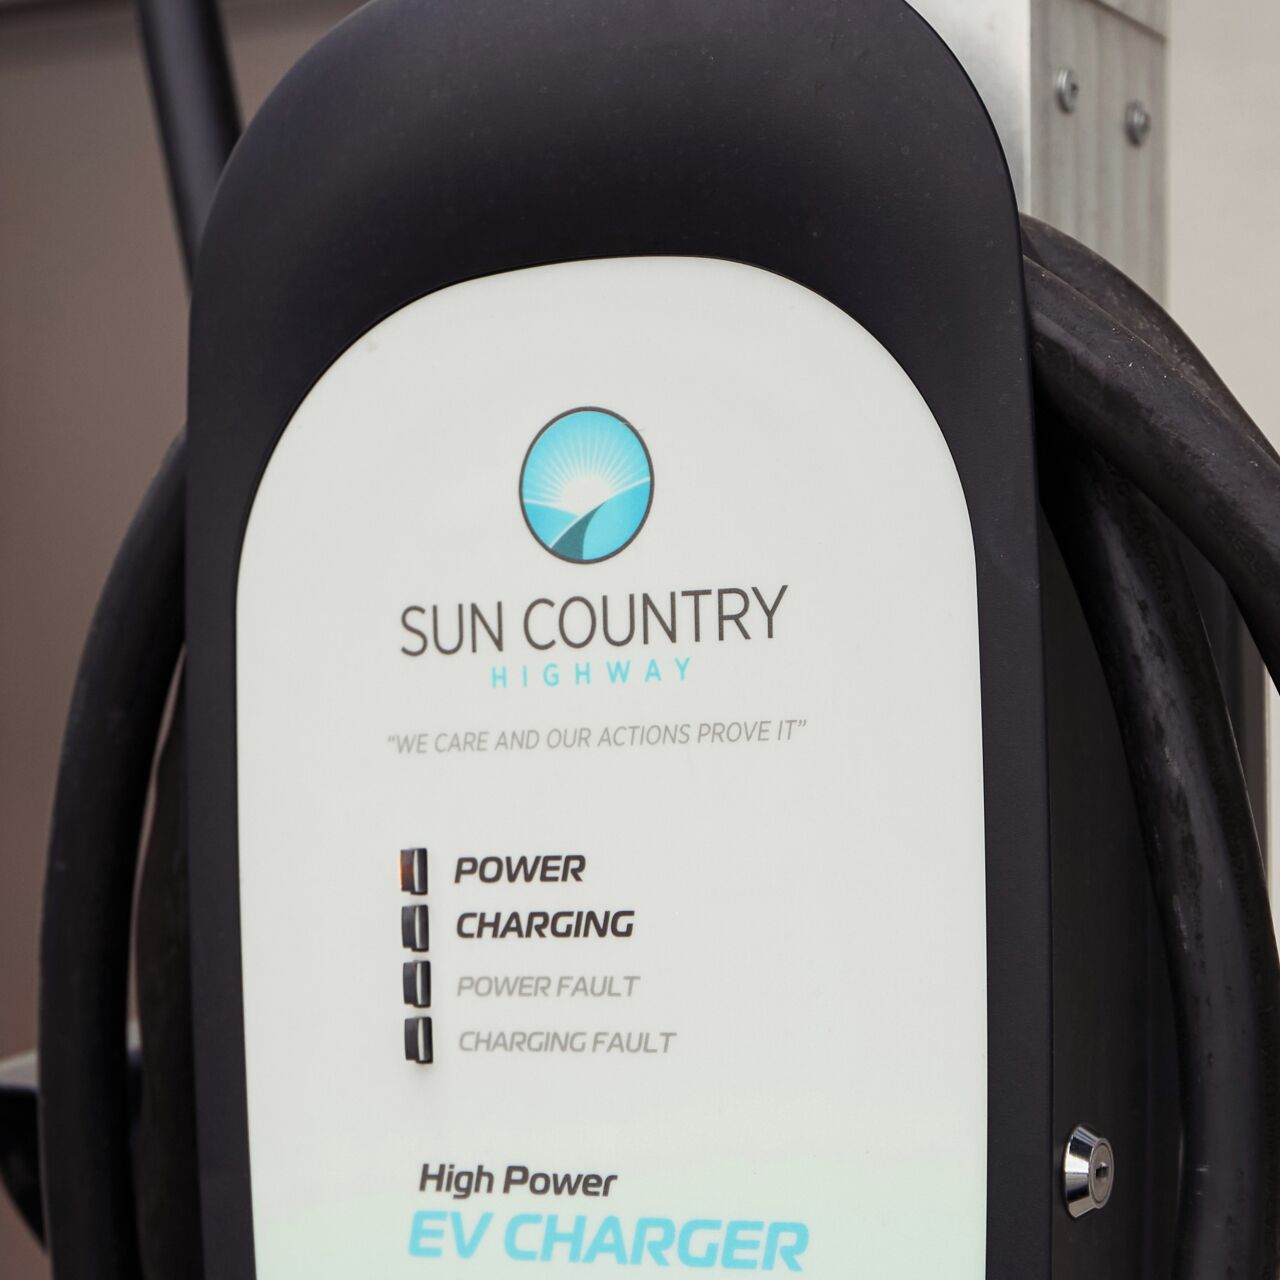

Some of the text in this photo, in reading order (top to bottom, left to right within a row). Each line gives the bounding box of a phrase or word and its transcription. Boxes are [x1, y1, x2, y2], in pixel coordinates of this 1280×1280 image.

[401, 585, 788, 657] SUN COUNTRY
[491, 657, 690, 688] HIGHWAY
[434, 731, 489, 753] CARE
[494, 729, 540, 750] AND
[546, 727, 592, 749] OUR
[597, 724, 691, 746] ACTIONS
[697, 721, 772, 743] PROVE
[455, 855, 586, 883] POWER
[457, 910, 635, 938] CHARGING
[457, 976, 641, 997] POWER FAULT
[459, 1031, 677, 1053] CHARGING FAULT
[419, 1164, 618, 1199] High Power
[408, 1211, 809, 1272] EV CHARGER
